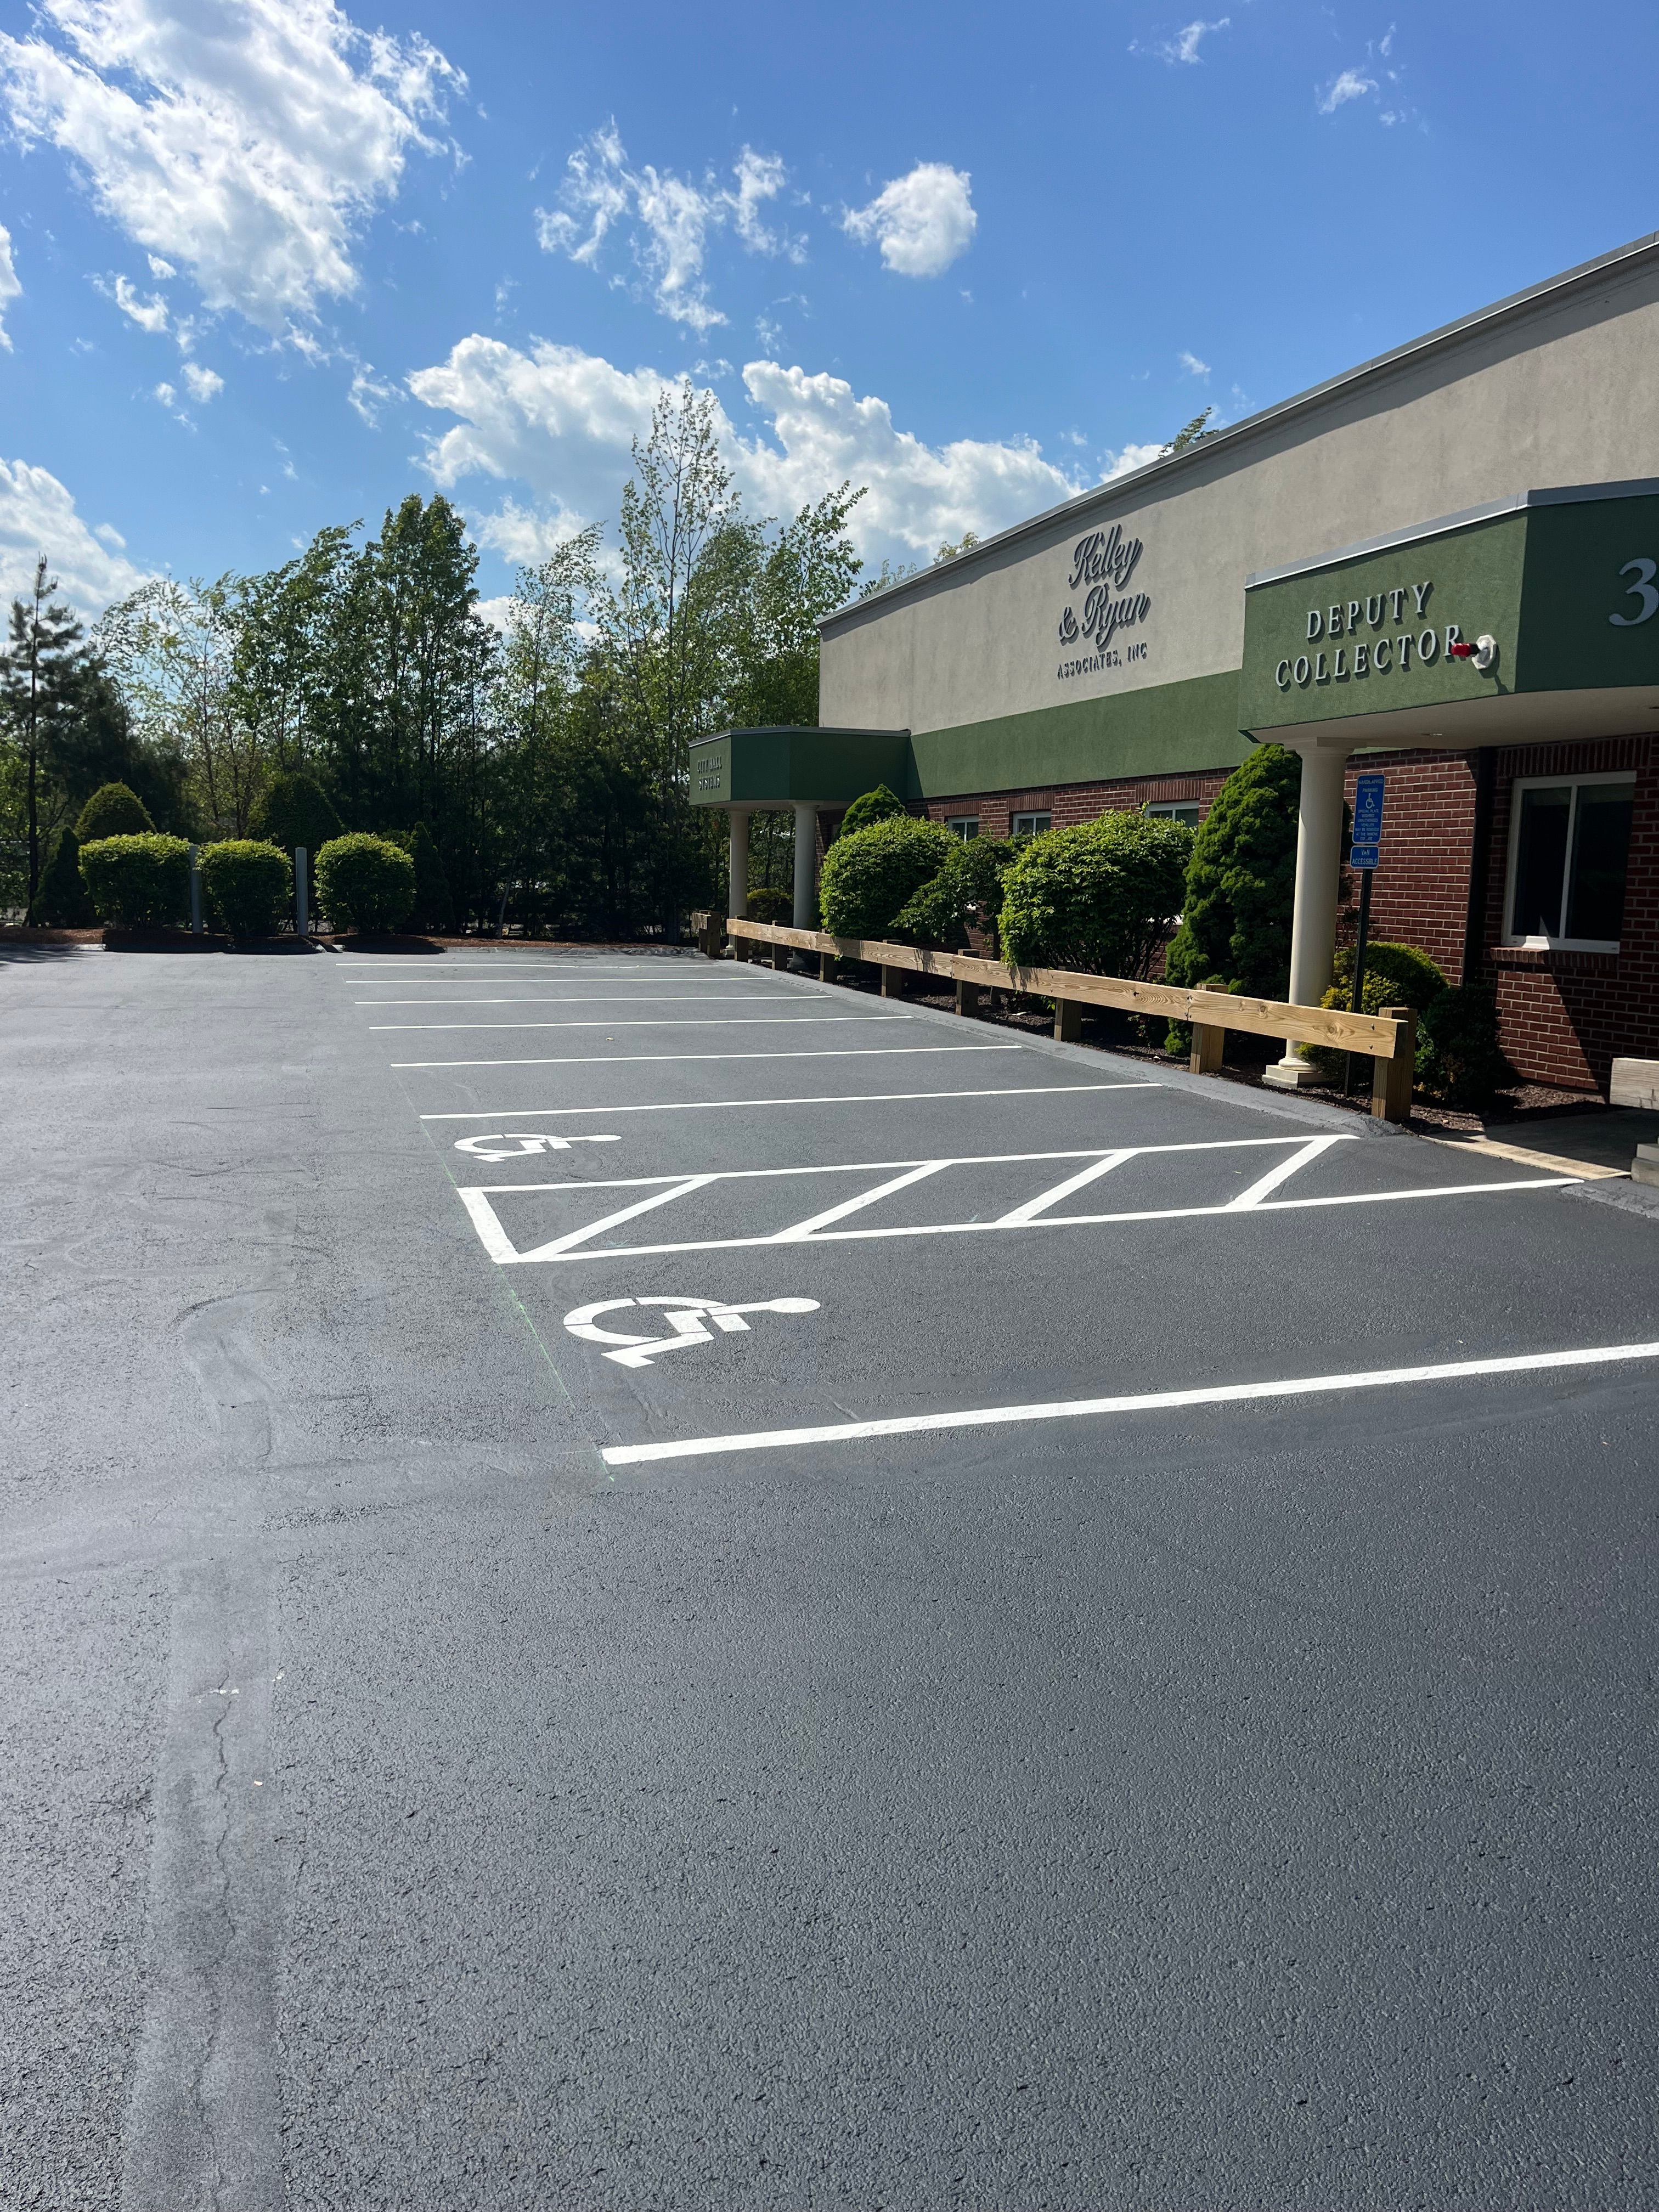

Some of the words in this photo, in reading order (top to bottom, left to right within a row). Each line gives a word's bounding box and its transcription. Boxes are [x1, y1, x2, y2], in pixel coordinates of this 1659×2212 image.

[1069, 524, 1143, 587] Kelley
[1059, 606, 1079, 642] &
[1082, 583, 1150, 647] Ryan
[1306, 581, 1431, 639] DEPUTY
[1609, 557, 1659, 626] 3
[1057, 650, 1122, 679] ASSOCIATES,
[1128, 642, 1147, 662] INC
[1275, 625, 1466, 686] COLLECTOR
